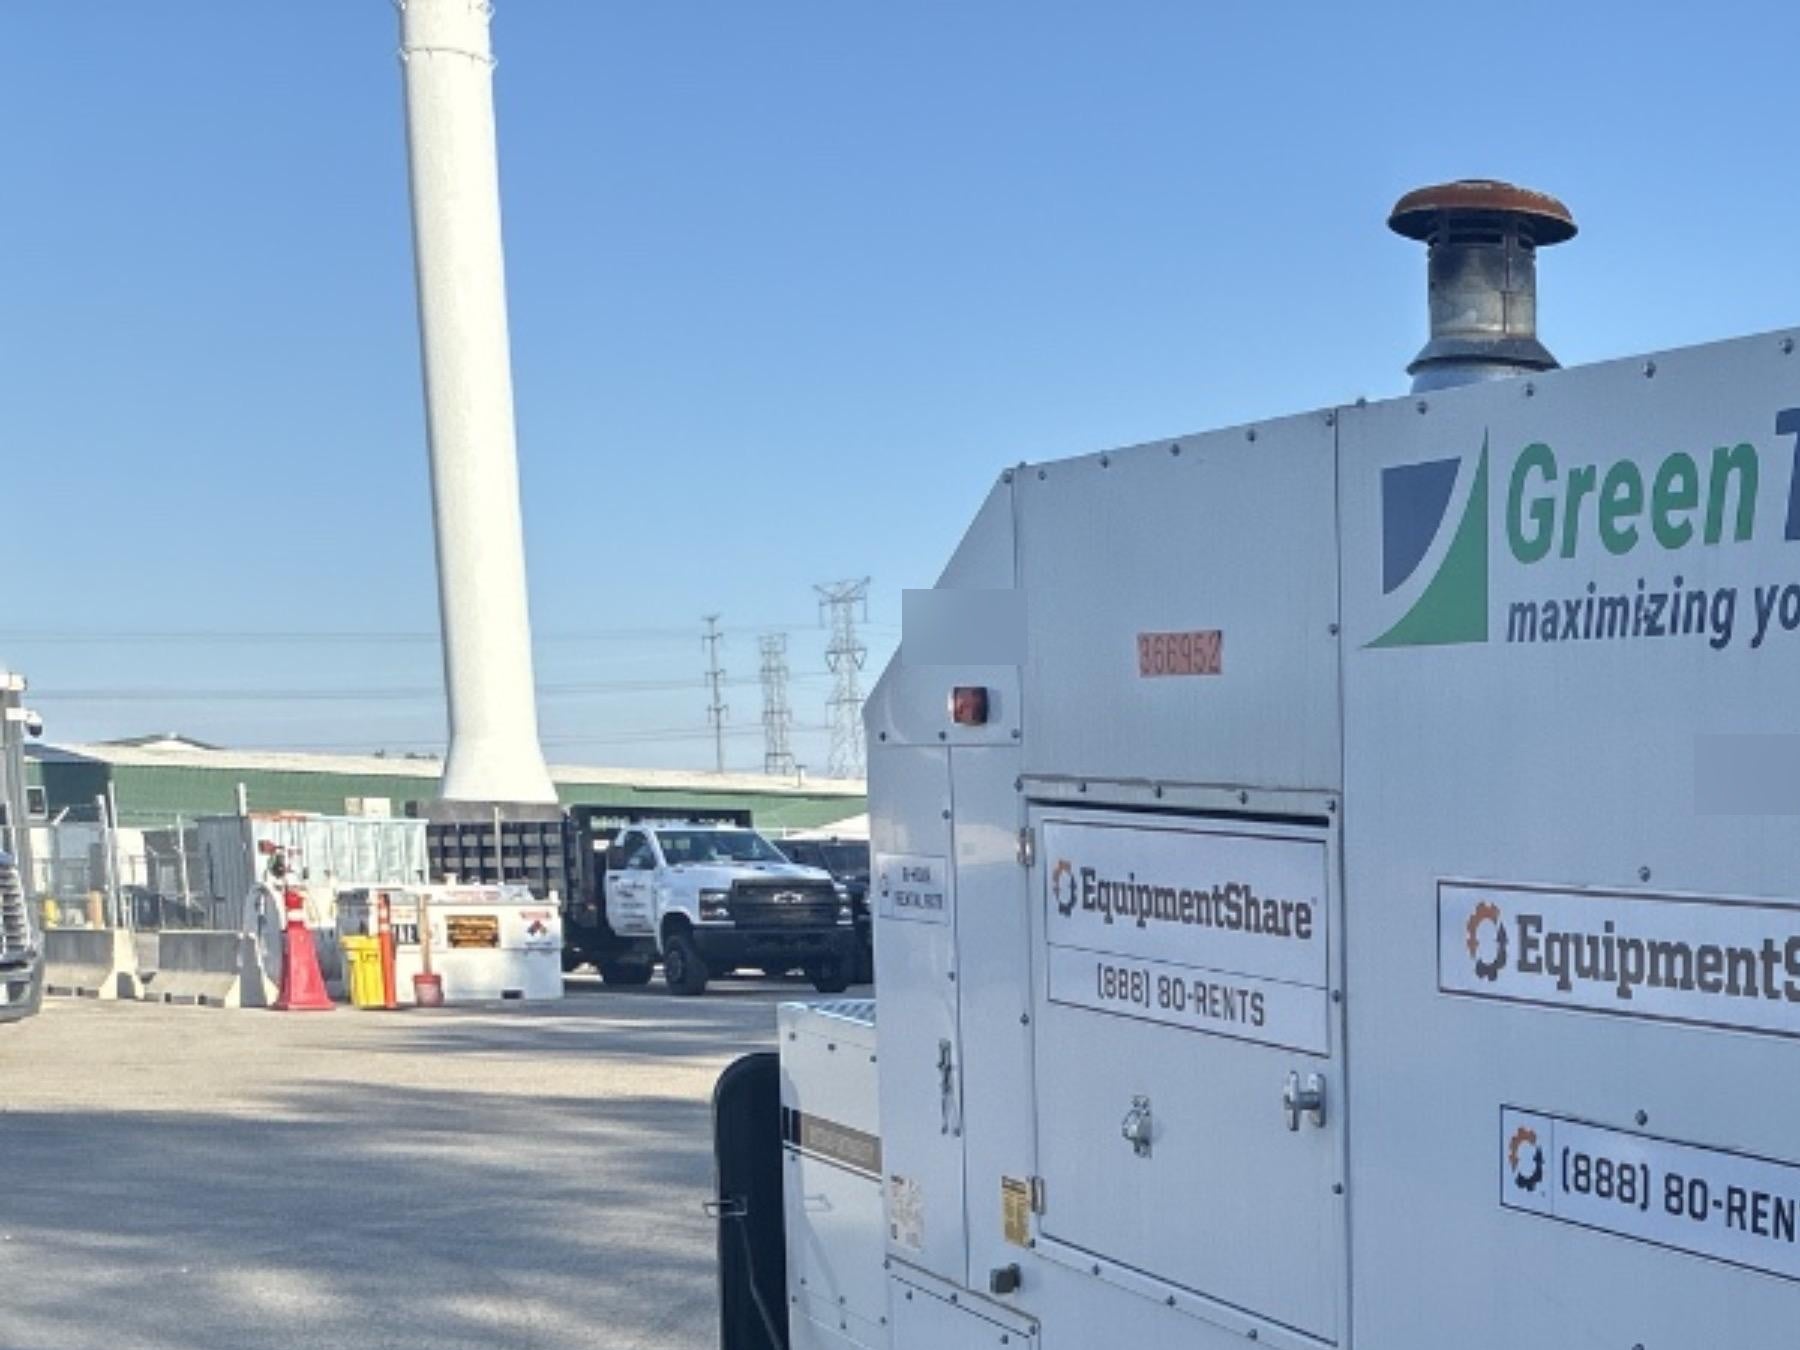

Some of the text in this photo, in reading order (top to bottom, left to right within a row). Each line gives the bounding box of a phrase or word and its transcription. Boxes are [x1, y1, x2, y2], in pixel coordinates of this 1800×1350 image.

[1506, 574, 1738, 651] maximizing
[1079, 866, 1313, 941] EquipmentShare
[1097, 961, 1266, 1028] (888) 80-RENTS
[1561, 1145, 1649, 1212] (888)
